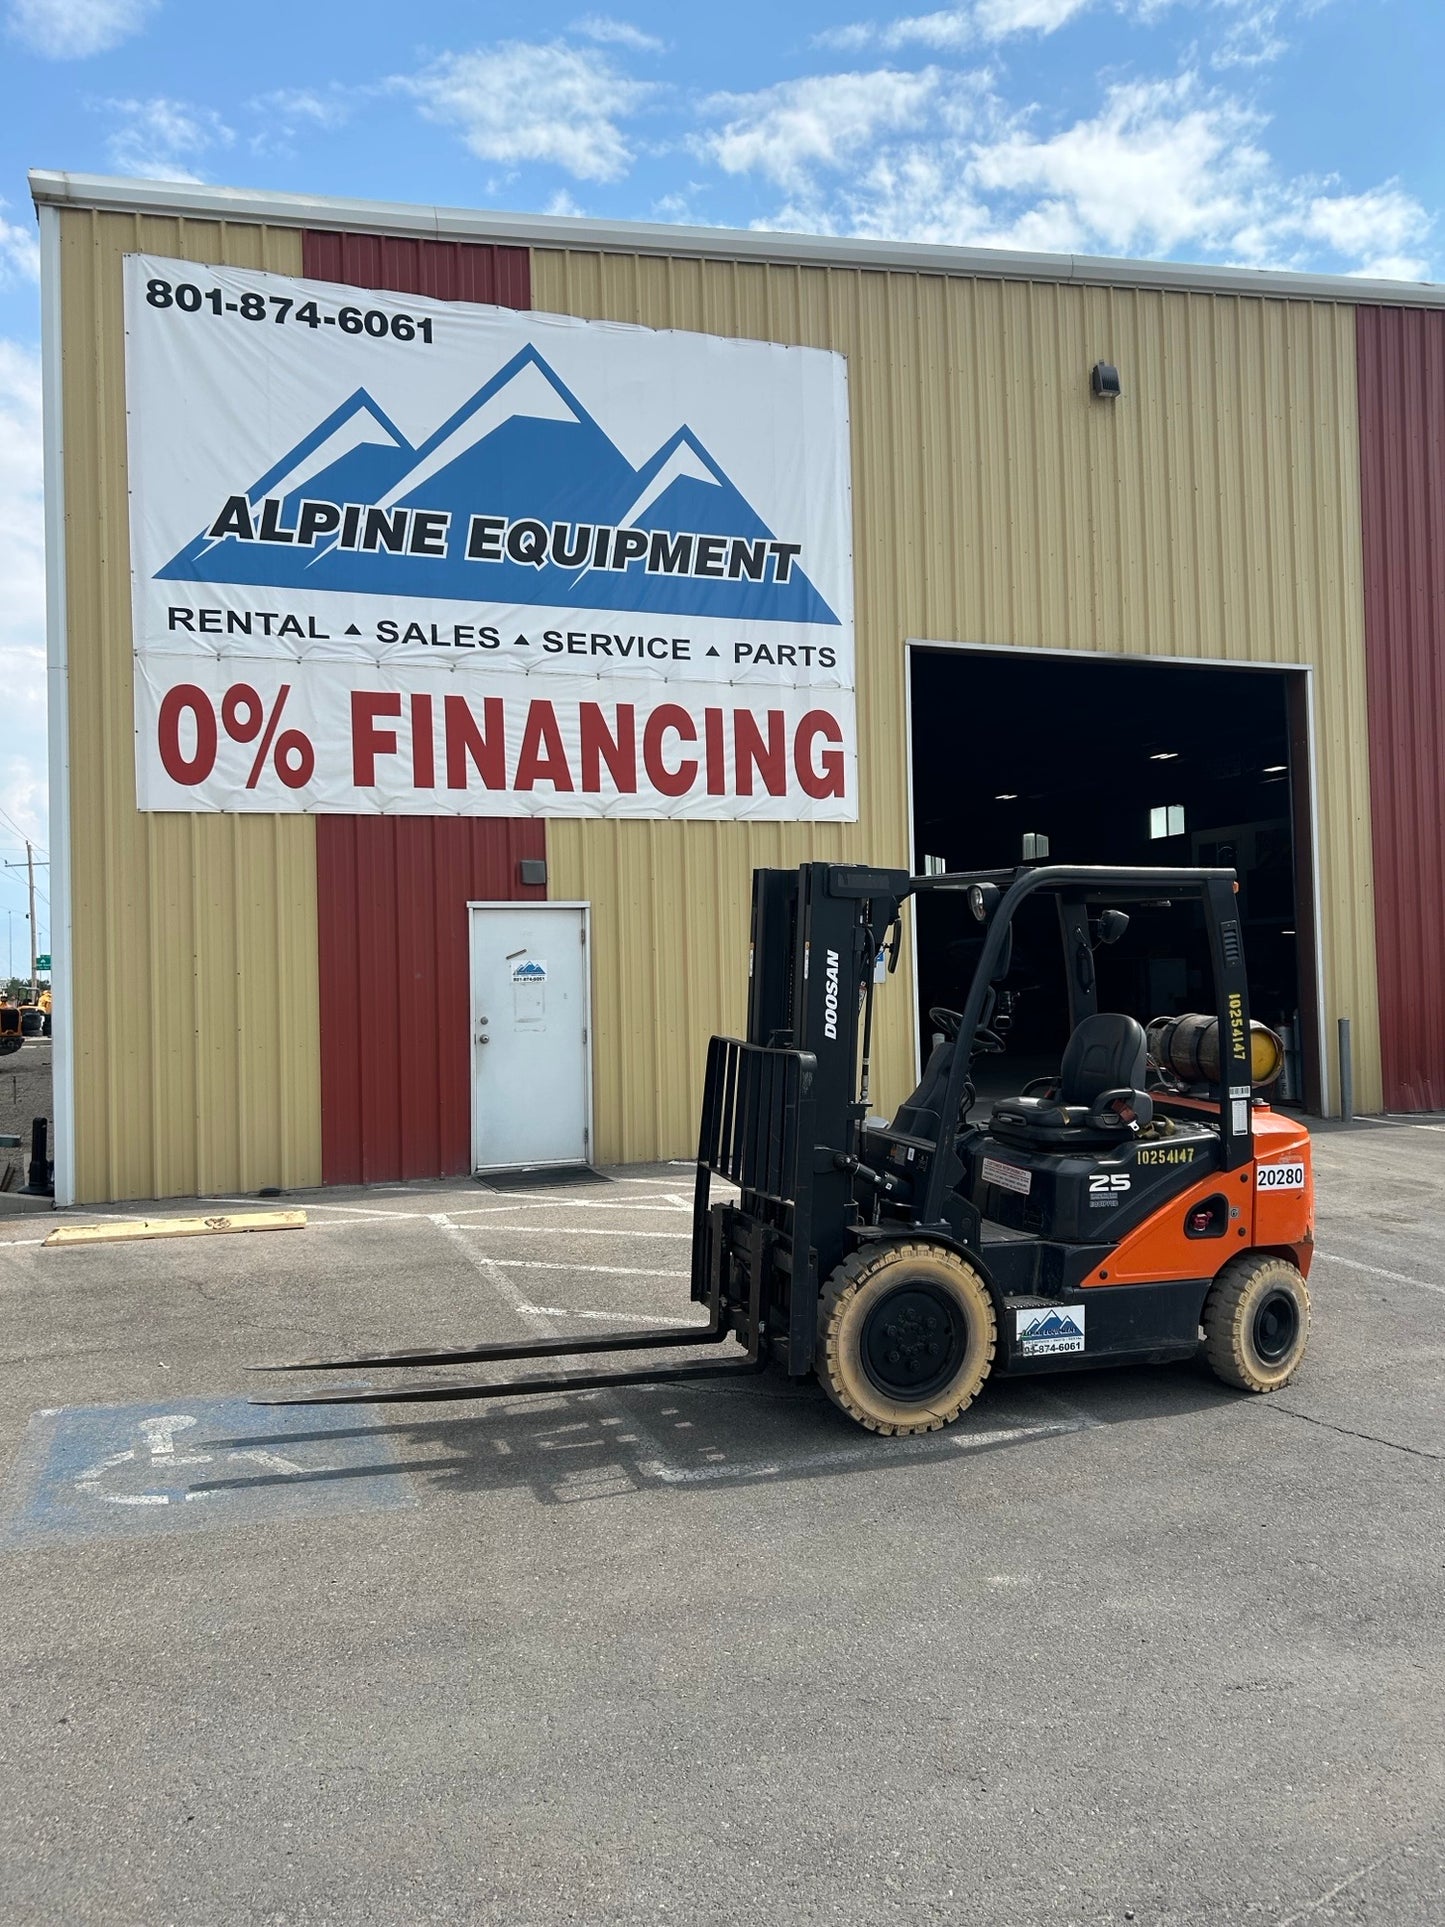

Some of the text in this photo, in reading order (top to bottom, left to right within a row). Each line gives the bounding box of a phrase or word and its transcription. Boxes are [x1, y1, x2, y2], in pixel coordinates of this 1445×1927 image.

[146, 279, 434, 344] 801-874-6061
[205, 494, 801, 584] ALPINE EQUIPMENT
[167, 606, 837, 668] RENTAL SALES SERVICE PARTS
[158, 682, 846, 800] 0% FINANCING
[825, 950, 839, 1040] DOOSAN
[1228, 992, 1246, 1060] 10254147
[1089, 1173, 1131, 1192] 25
[1137, 1147, 1194, 1165] 10254147
[1257, 1167, 1303, 1186] 20280
